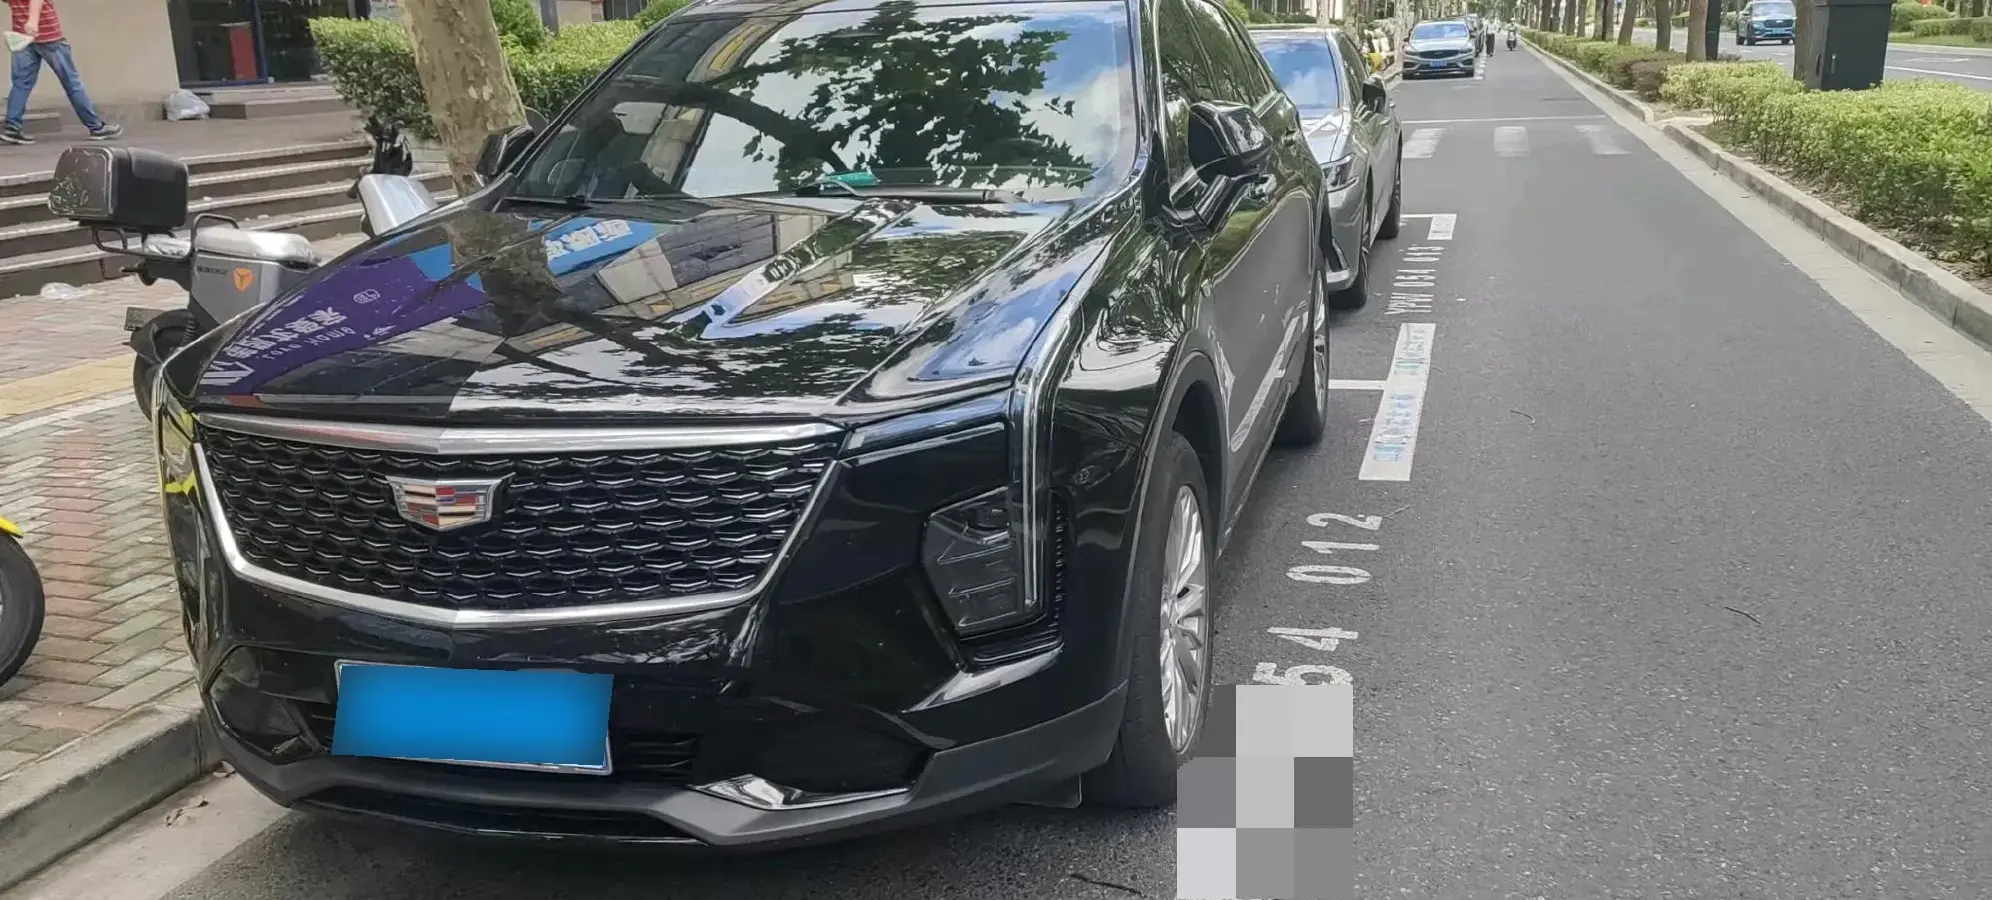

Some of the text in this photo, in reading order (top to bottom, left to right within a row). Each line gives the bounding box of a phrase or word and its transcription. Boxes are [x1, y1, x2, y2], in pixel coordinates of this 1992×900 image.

[1402, 246, 1444, 262] 013
[1393, 269, 1436, 287] 054
[1384, 292, 1434, 315] YPW
[1286, 512, 1382, 585] 012
